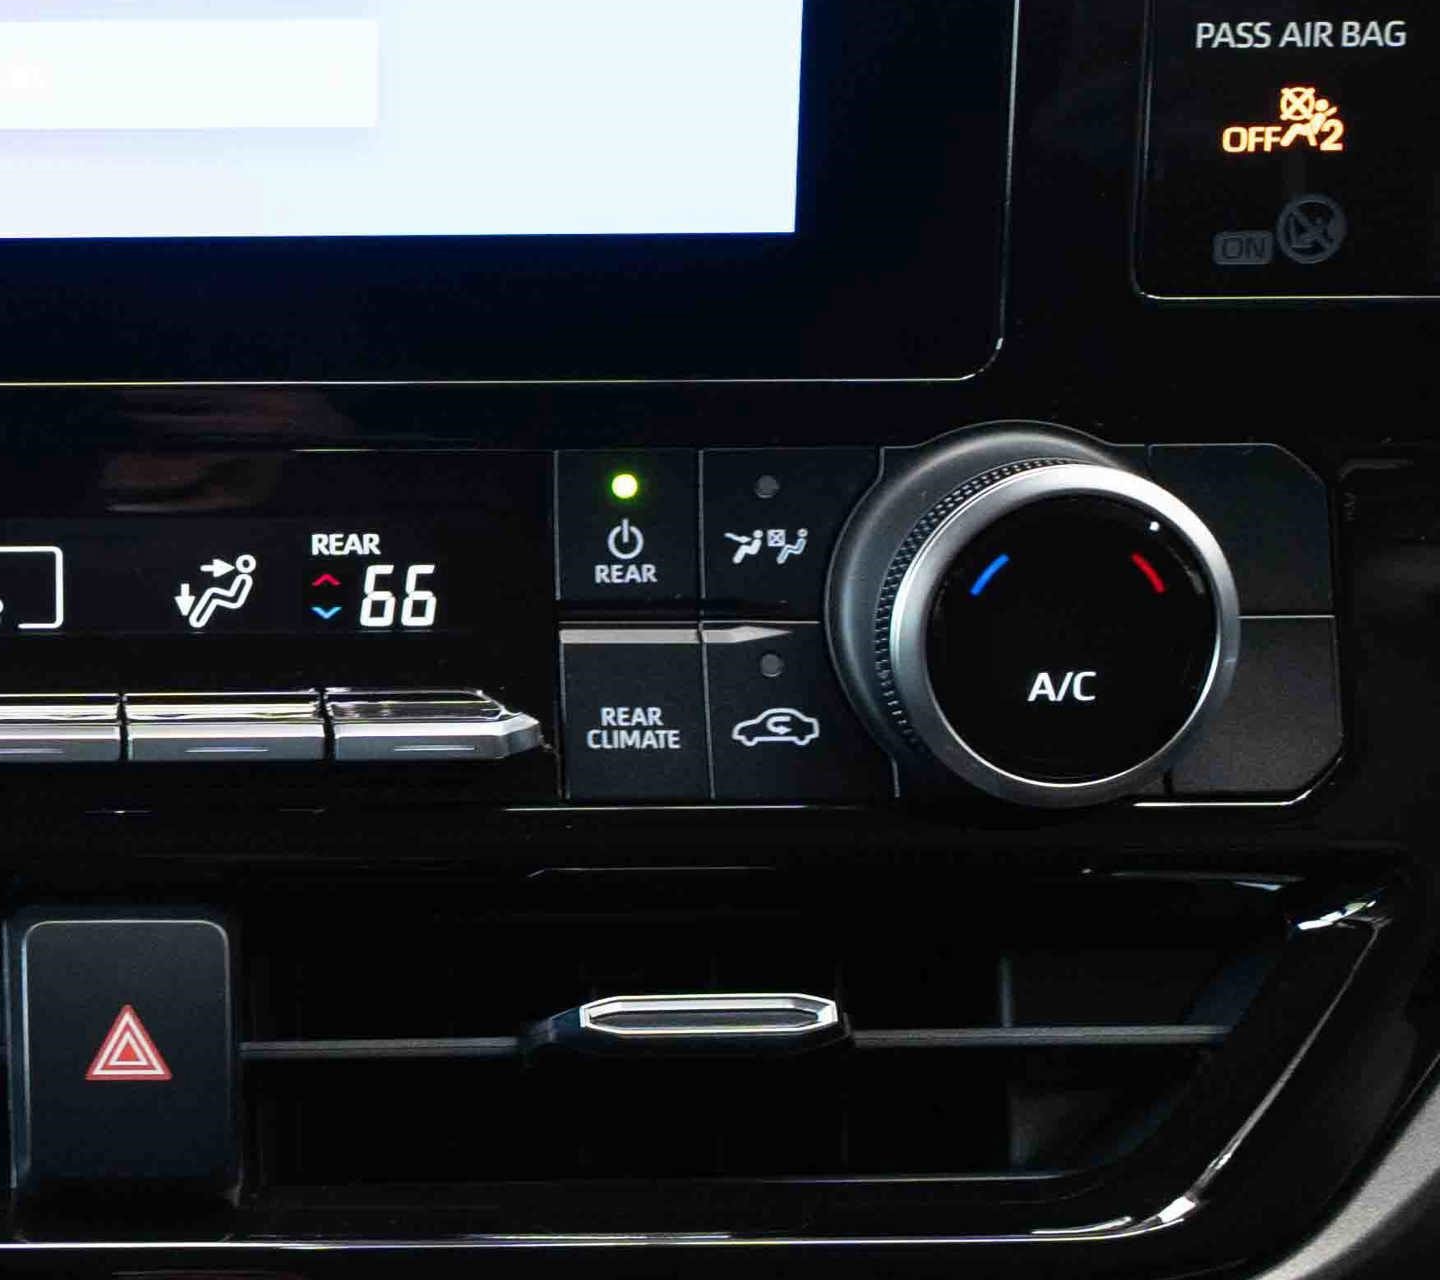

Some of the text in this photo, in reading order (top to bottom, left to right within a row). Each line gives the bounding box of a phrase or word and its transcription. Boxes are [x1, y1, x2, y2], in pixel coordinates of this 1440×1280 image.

[1195, 20, 1407, 49] PASS AIR BAG
[1222, 126, 1281, 154] OFF
[1221, 238, 1266, 258] ON
[311, 534, 380, 556] REAR
[594, 563, 657, 584] REAR
[359, 564, 437, 627] 66
[1027, 671, 1097, 703] A/C
[601, 707, 663, 727] REAR
[586, 727, 681, 750] CLIMATE
